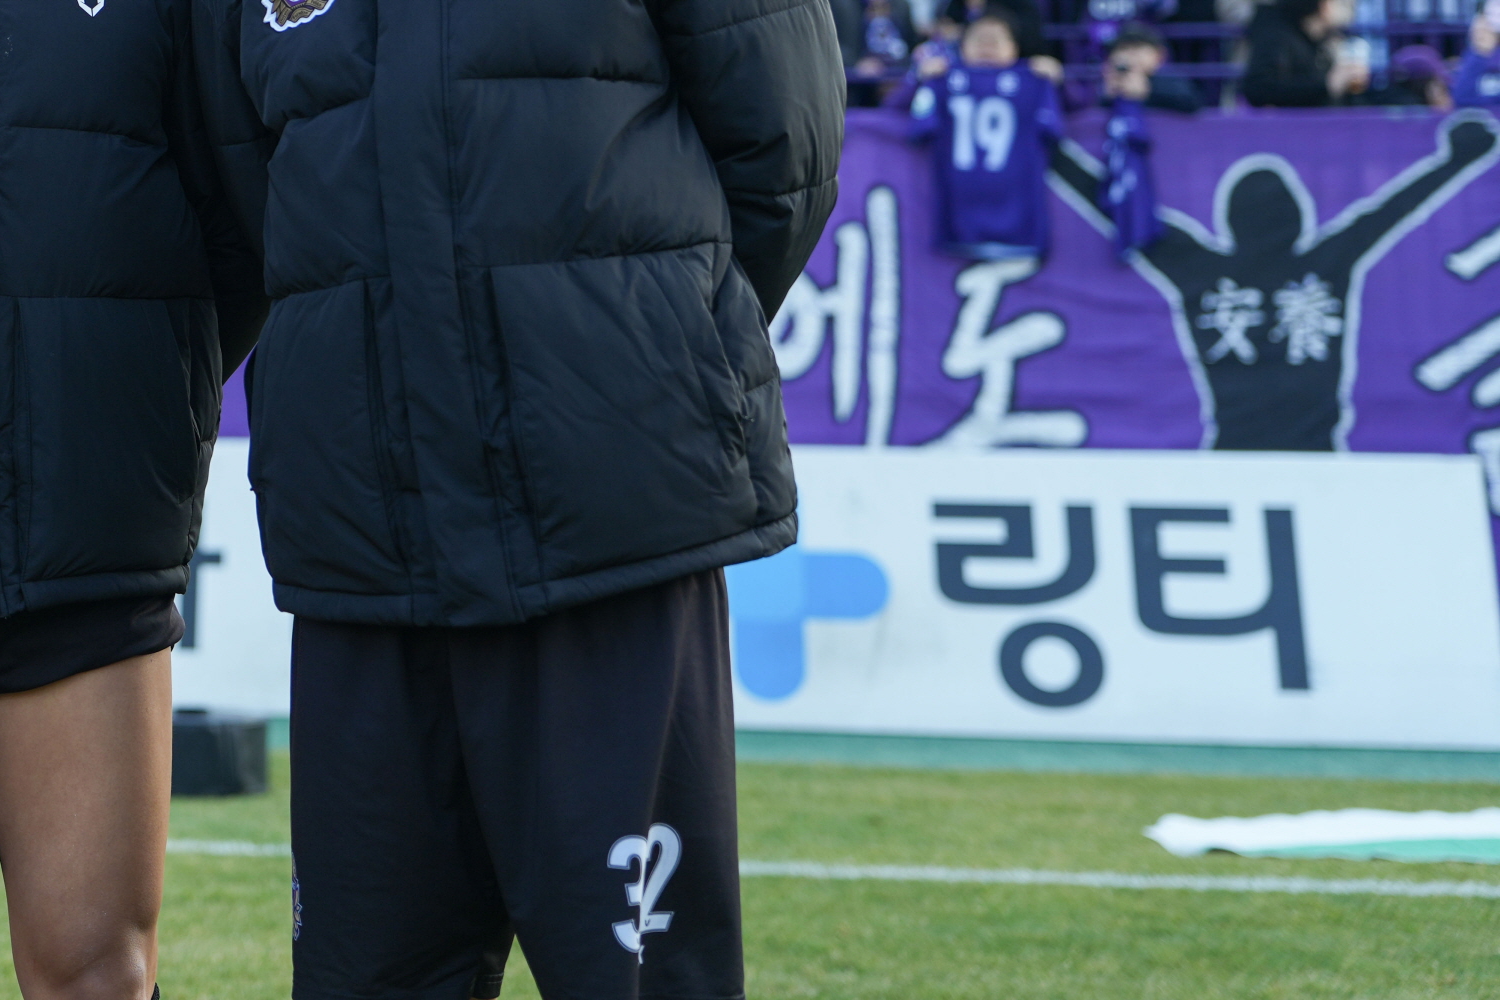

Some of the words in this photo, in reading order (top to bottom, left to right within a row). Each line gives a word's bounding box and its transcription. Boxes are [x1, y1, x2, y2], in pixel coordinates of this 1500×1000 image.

[947, 96, 1017, 171] 19
[932, 502, 1311, 708] 링티
[607, 822, 683, 954] 32
